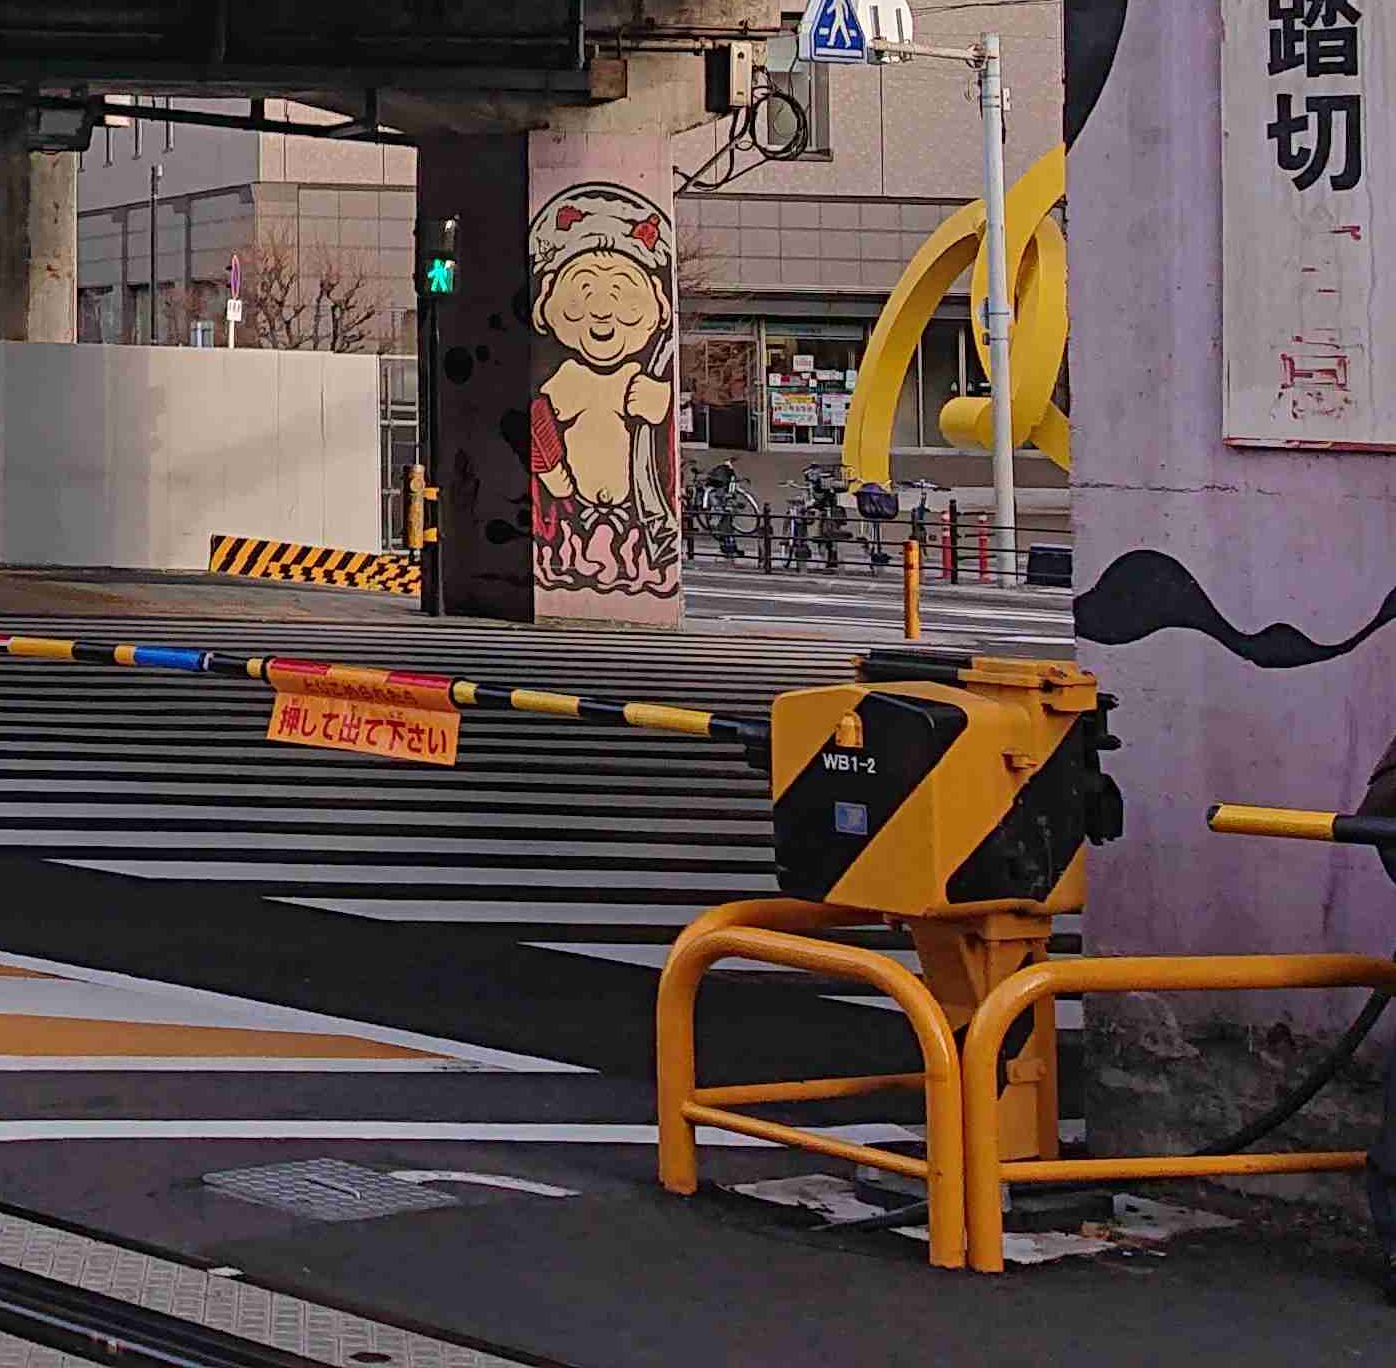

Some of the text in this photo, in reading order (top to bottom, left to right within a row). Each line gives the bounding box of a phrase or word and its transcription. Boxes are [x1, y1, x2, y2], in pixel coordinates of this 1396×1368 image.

[278, 702, 448, 755] 押して出て下さい
[823, 753, 878, 774] WB1-2
